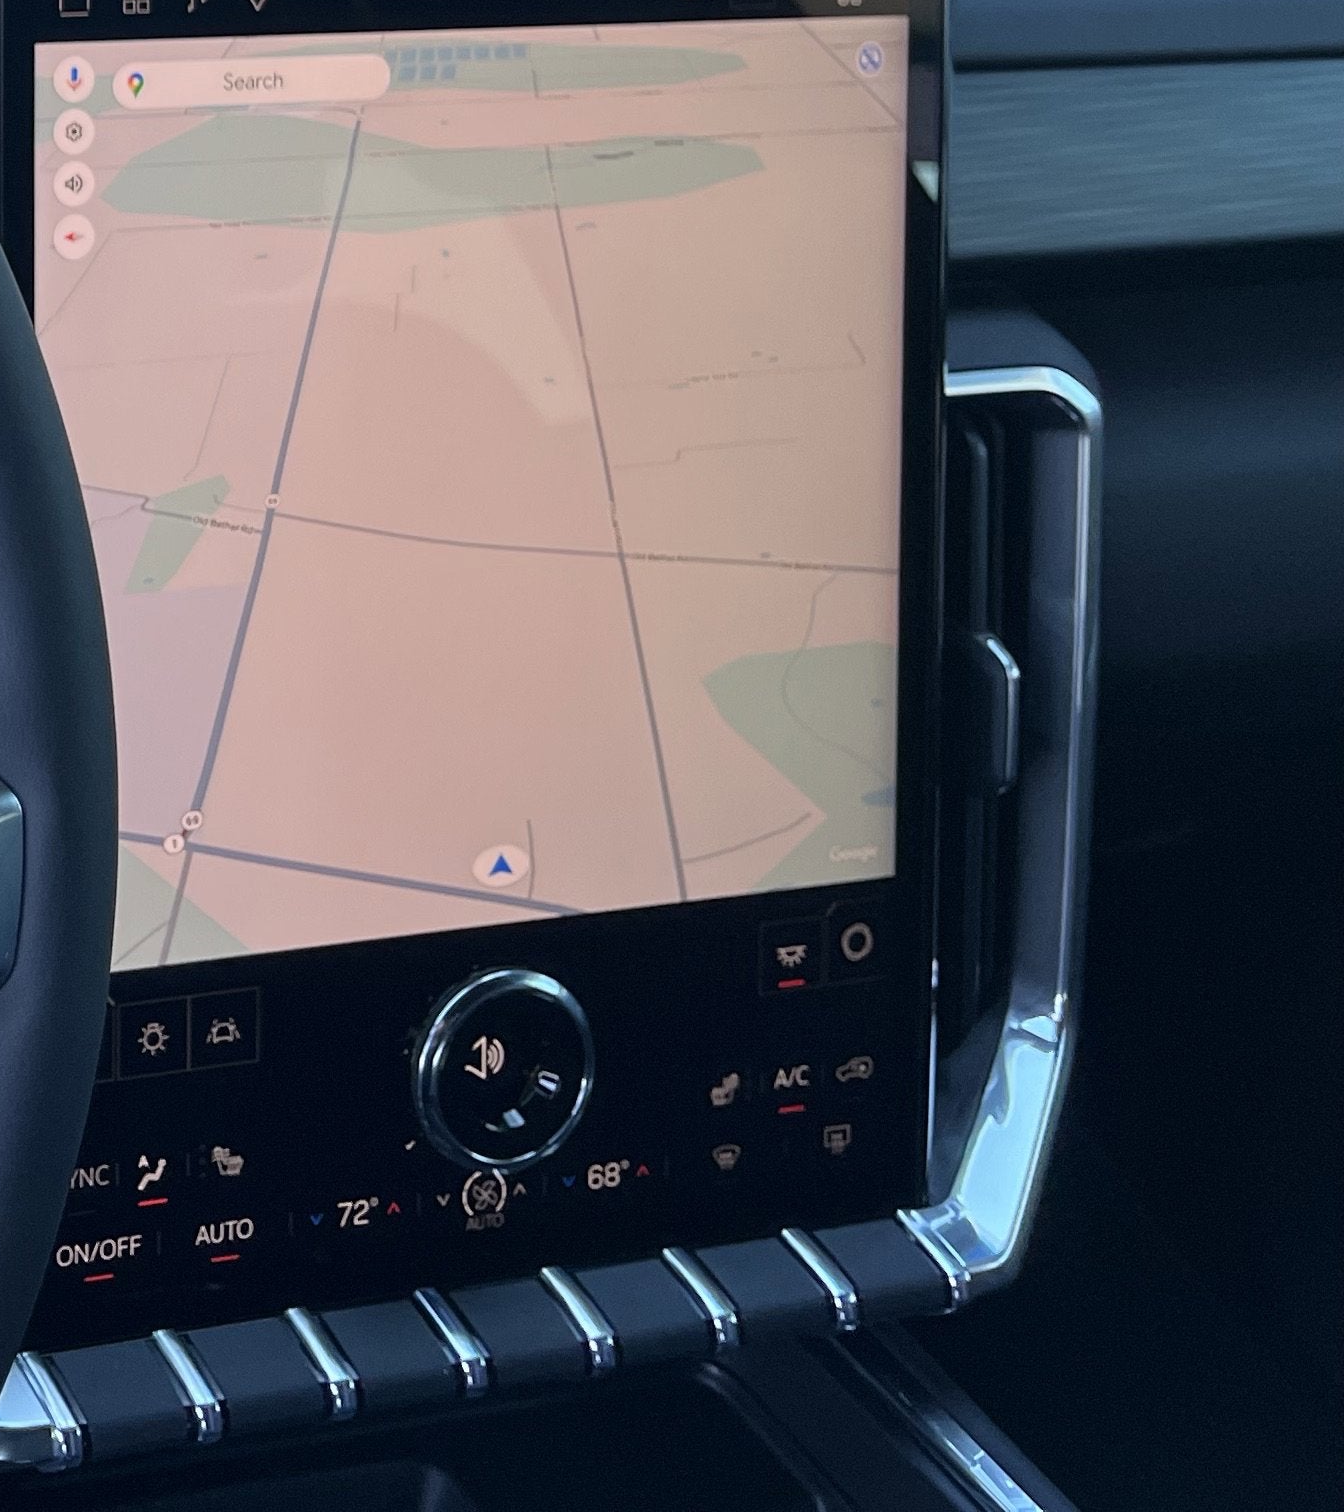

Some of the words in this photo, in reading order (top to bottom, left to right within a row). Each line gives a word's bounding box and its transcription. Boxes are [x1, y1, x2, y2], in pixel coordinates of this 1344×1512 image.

[222, 72, 286, 91] Search
[774, 1065, 811, 1089] A/C
[195, 1218, 255, 1246] AUTO
[56, 1234, 143, 1267] ON/OFF
